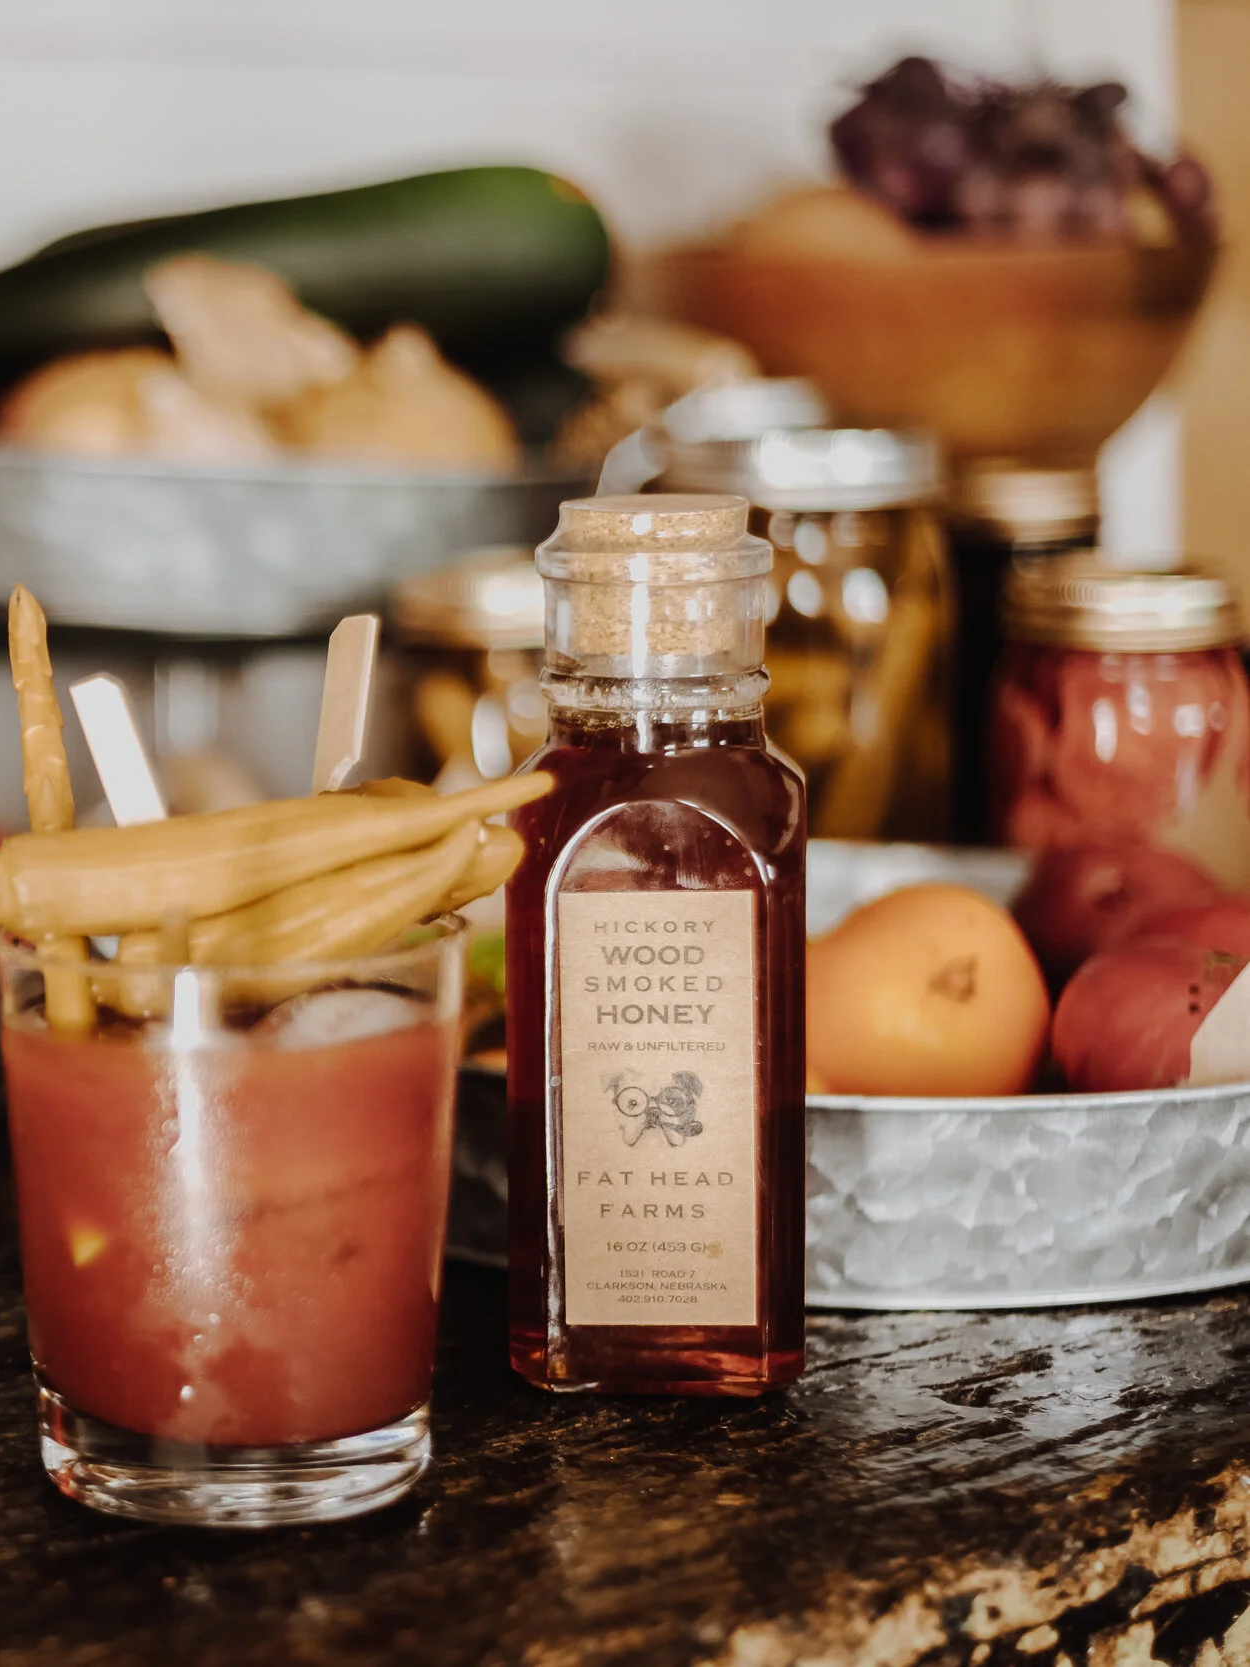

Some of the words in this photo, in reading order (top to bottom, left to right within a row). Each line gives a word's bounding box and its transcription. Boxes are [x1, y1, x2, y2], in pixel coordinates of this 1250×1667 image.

[594, 920, 716, 934] HICKORY
[601, 945, 705, 966] WOOD
[584, 975, 724, 993] SMOKED
[596, 1004, 717, 1025] HONEY
[588, 1041, 620, 1051] RAW
[623, 1041, 635, 1051] &
[636, 1041, 726, 1051] UNFILTERED
[577, 1171, 634, 1186] FAT
[650, 1171, 734, 1186] HEAD
[600, 1203, 706, 1219] FARMS
[606, 1241, 623, 1252] 16
[626, 1241, 648, 1252] OZ
[652, 1241, 687, 1253] (453
[690, 1241, 707, 1253] G)
[651, 1269, 686, 1278] ROAD
[586, 1281, 657, 1291] CLARKSON,
[660, 1281, 728, 1291] NEBRASKA
